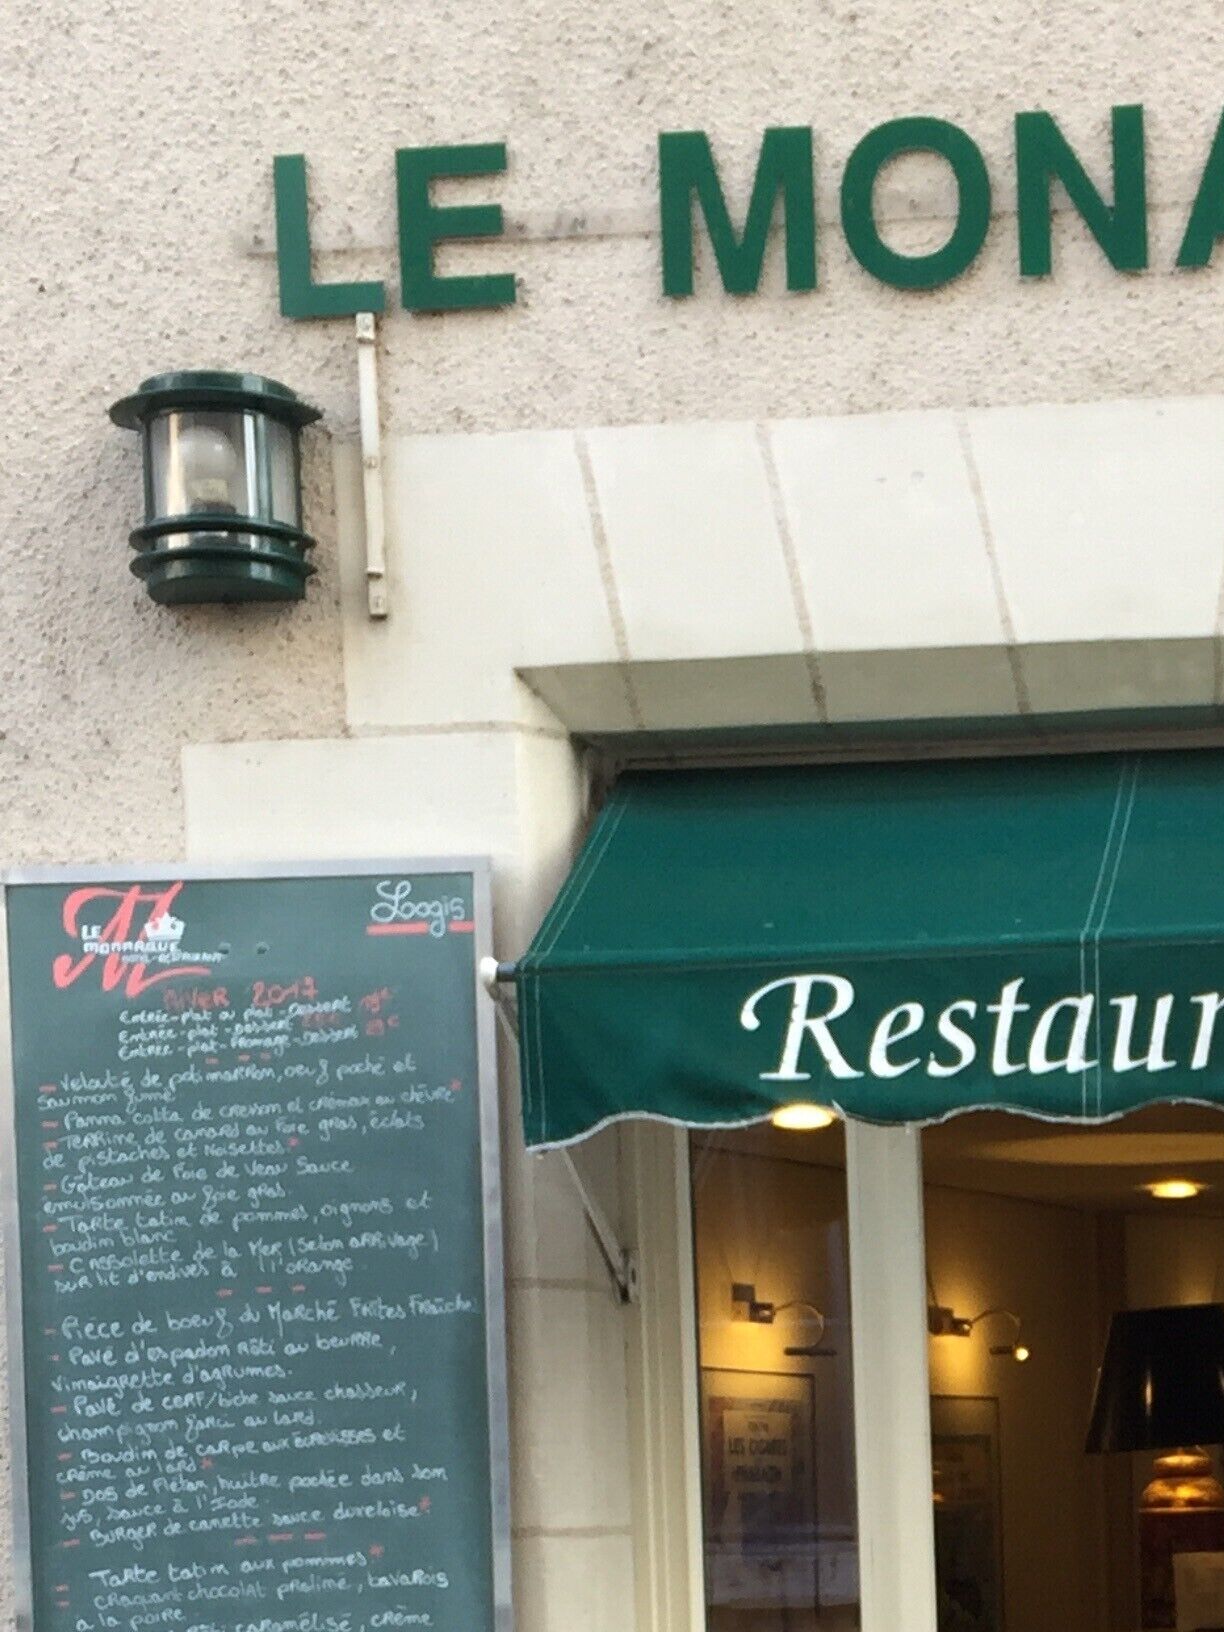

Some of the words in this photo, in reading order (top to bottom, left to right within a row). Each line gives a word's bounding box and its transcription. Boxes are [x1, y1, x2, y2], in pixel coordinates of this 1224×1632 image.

[273, 142, 516, 318] LE
[131, 1311, 158, 1335] de
[131, 1390, 155, 1414] de
[164, 1438, 188, 1460] de
[125, 1478, 149, 1500] de
[163, 1518, 183, 1536] de
